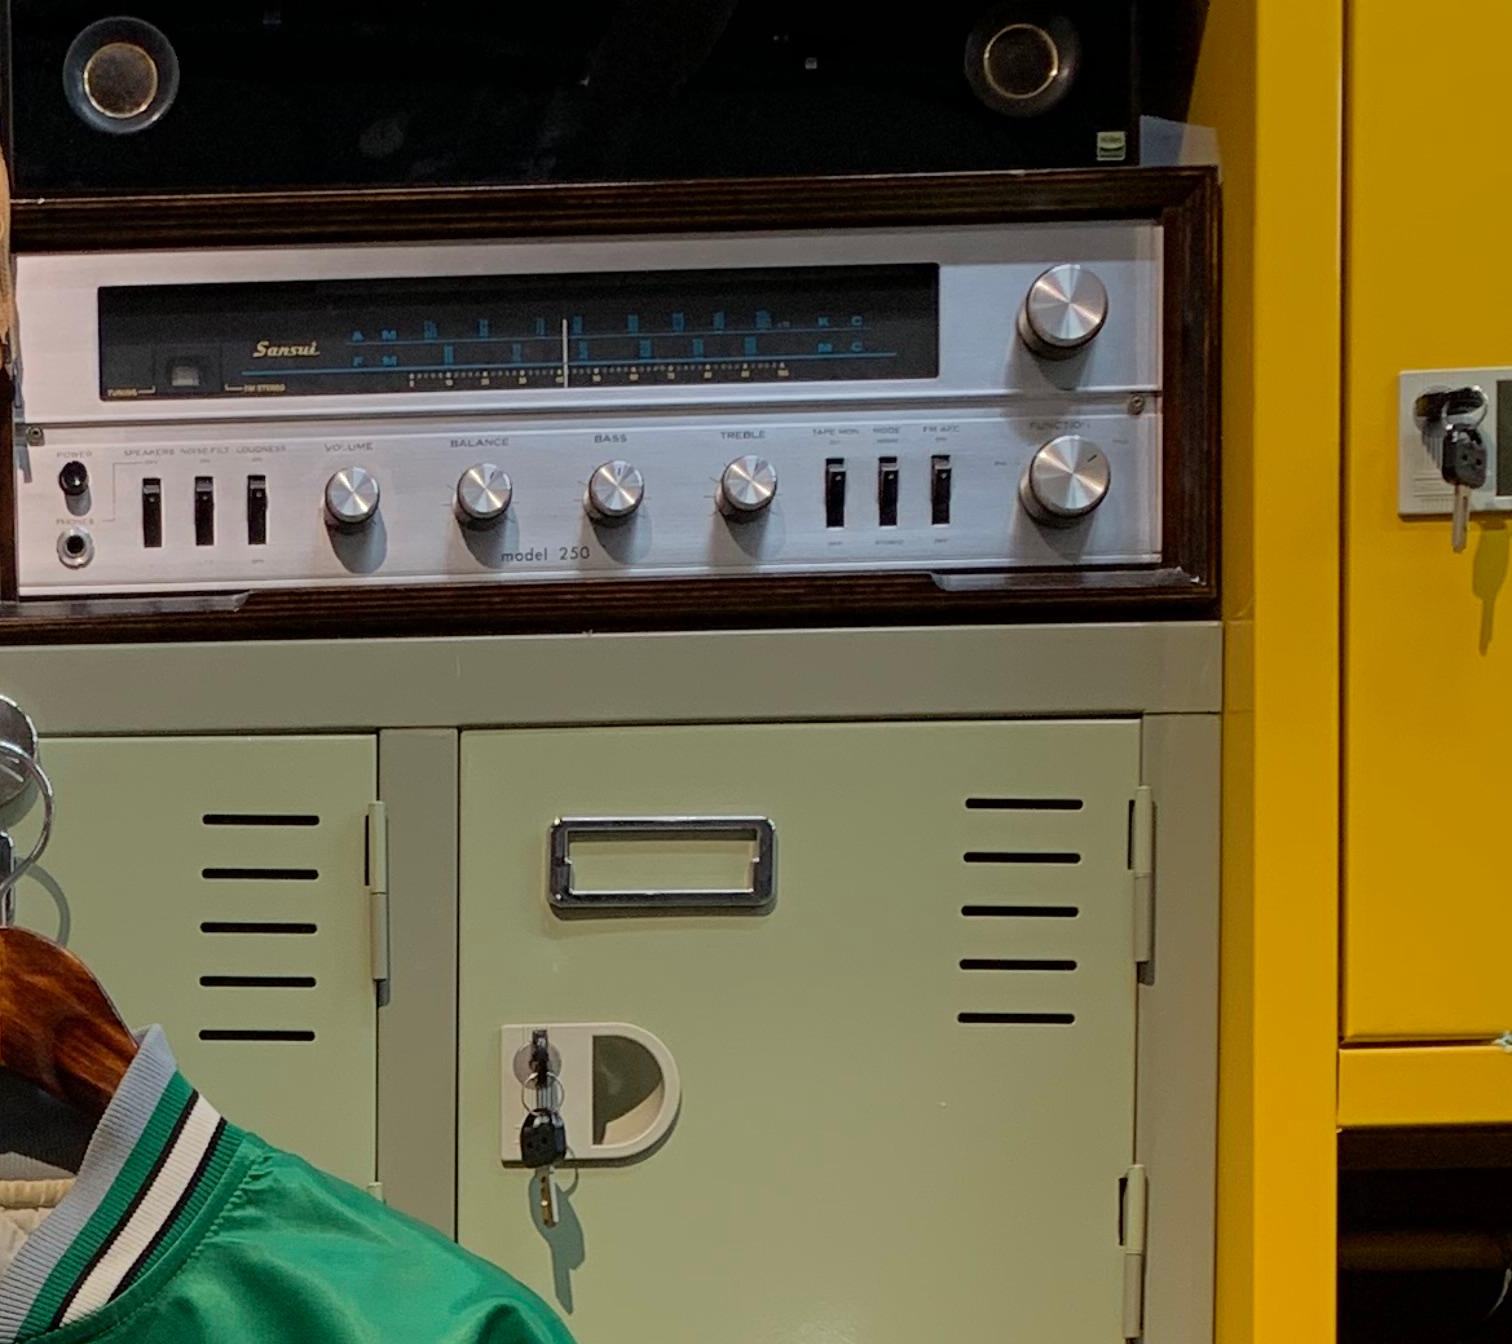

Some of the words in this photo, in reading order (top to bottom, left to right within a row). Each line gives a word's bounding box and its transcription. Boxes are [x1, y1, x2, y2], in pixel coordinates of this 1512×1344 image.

[252, 340, 320, 358] Sansui
[1029, 421, 1090, 431] FUNCTIO
[593, 433, 628, 444] BASS
[720, 429, 767, 440] TREBLE
[323, 442, 374, 452] VOLUME
[449, 437, 510, 449] BALANCE
[500, 547, 548, 562] model
[559, 545, 591, 561] 250
